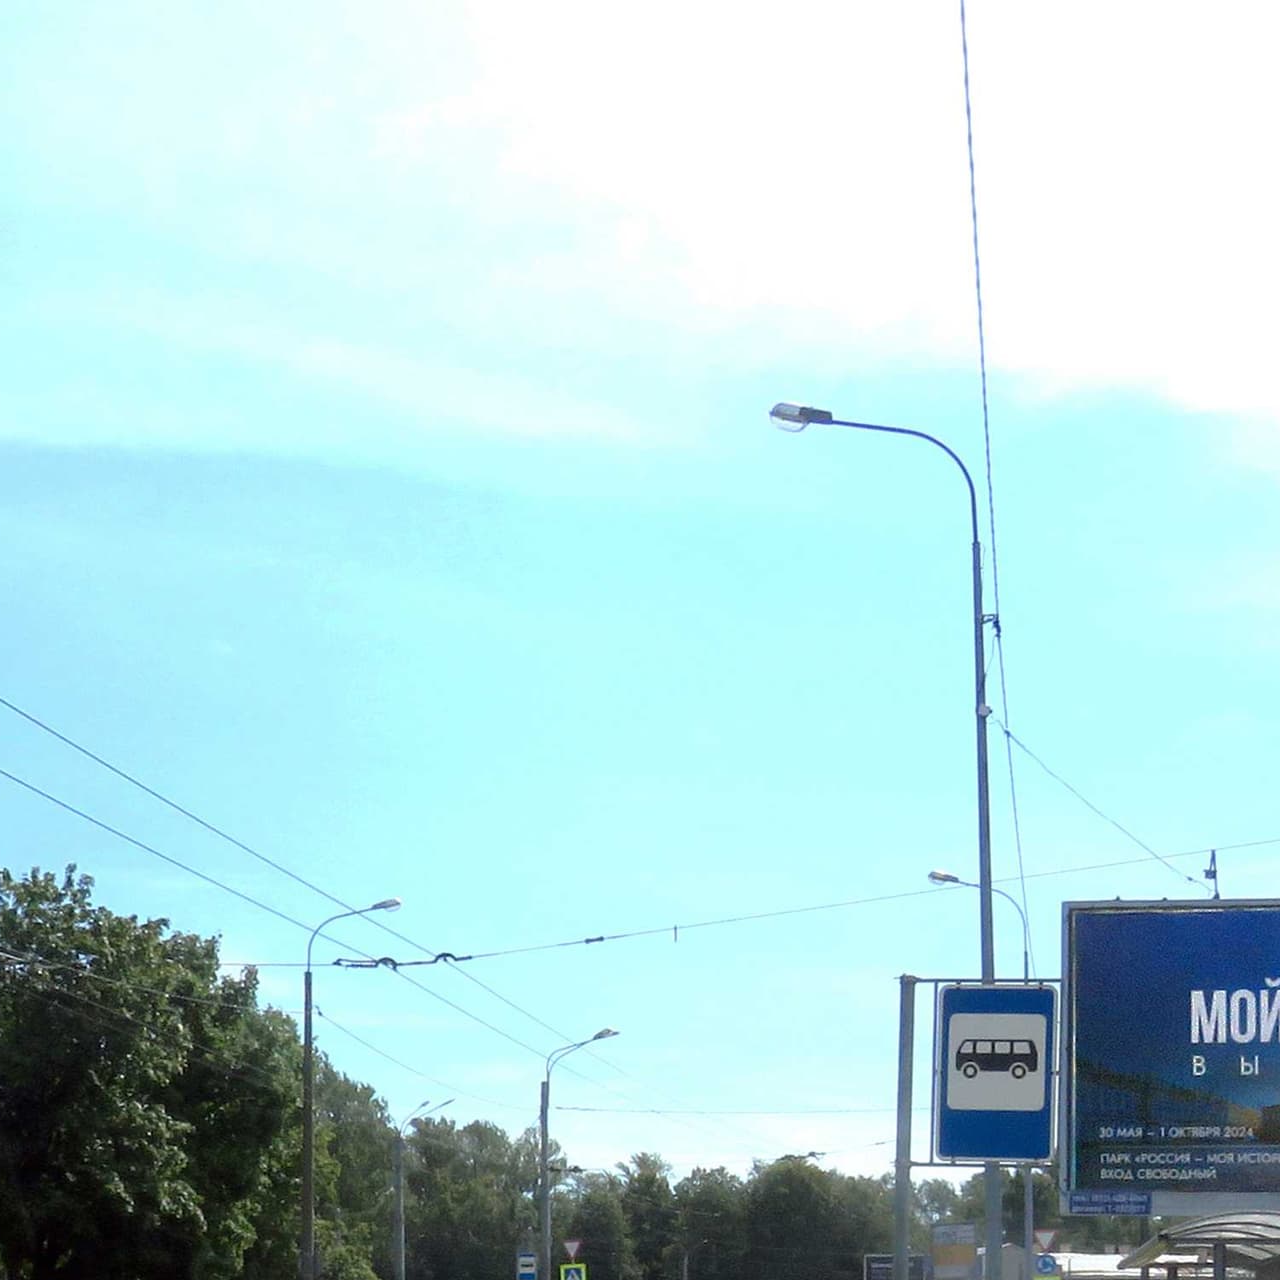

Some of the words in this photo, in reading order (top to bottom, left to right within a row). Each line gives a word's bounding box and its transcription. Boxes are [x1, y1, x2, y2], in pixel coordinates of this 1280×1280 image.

[1099, 1127, 1114, 1139] 30
[1116, 1127, 1143, 1138] МАЯ
[1168, 1126, 1222, 1138] ОКТЯБРЯ
[1223, 1126, 1254, 1138] 2024
[1100, 1153, 1131, 1164] ПАРК
[1134, 1153, 1191, 1164] «РОССИЯ
[1206, 1153, 1237, 1164] МОЯ
[1100, 1169, 1134, 1181] ВХОД
[1136, 1166, 1217, 1181] СВОБОДНЫЙ
